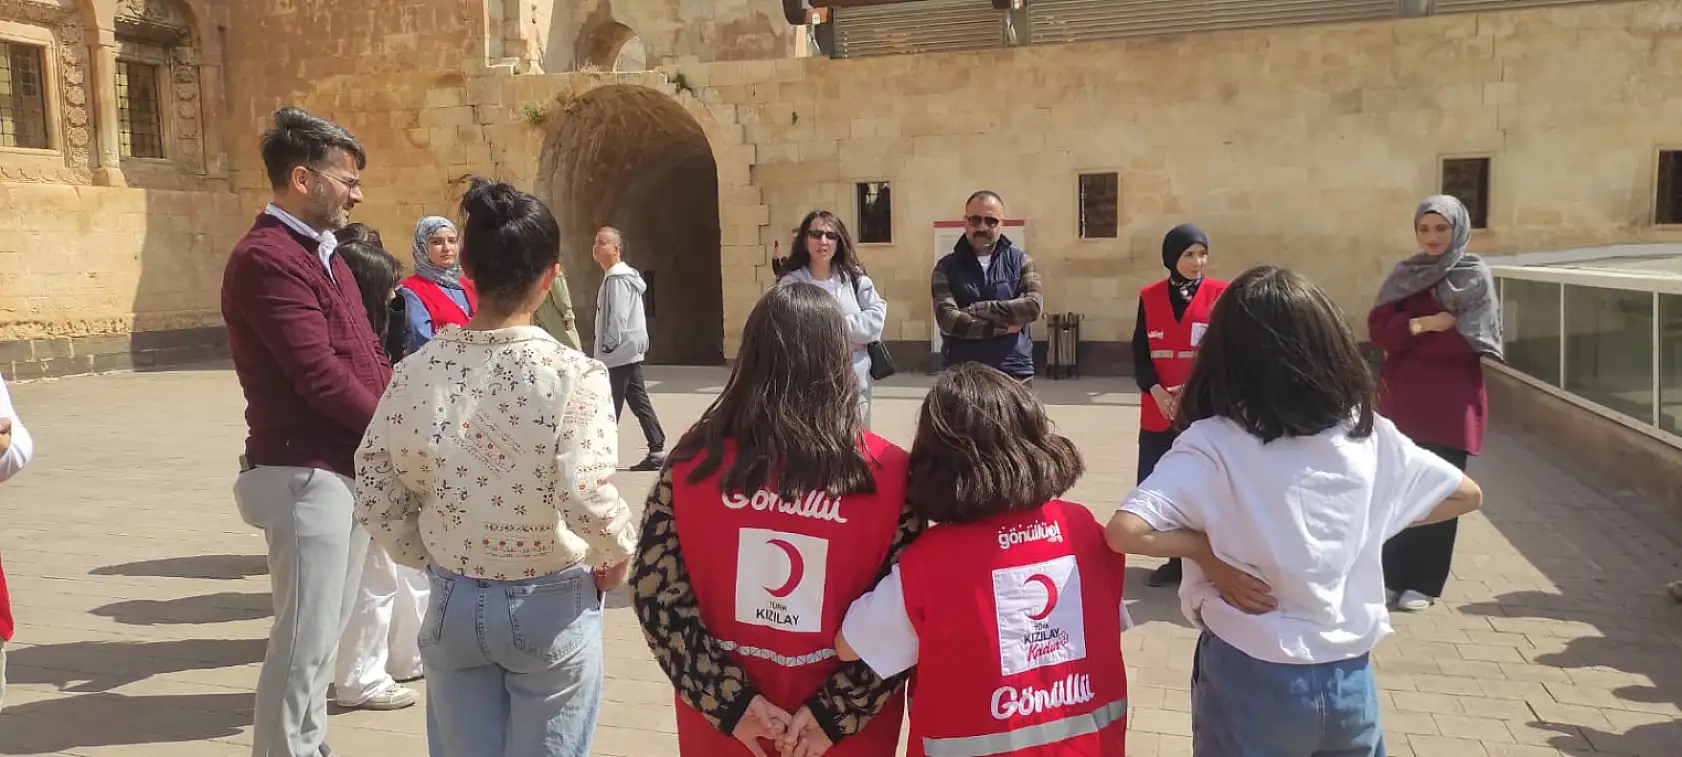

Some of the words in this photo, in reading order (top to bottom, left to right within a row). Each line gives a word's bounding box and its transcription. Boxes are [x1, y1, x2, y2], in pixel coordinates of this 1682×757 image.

[756, 608, 800, 626] KIZILAY
[1023, 627, 1060, 644] KIZILAY
[990, 672, 1095, 720] Gönüllü
